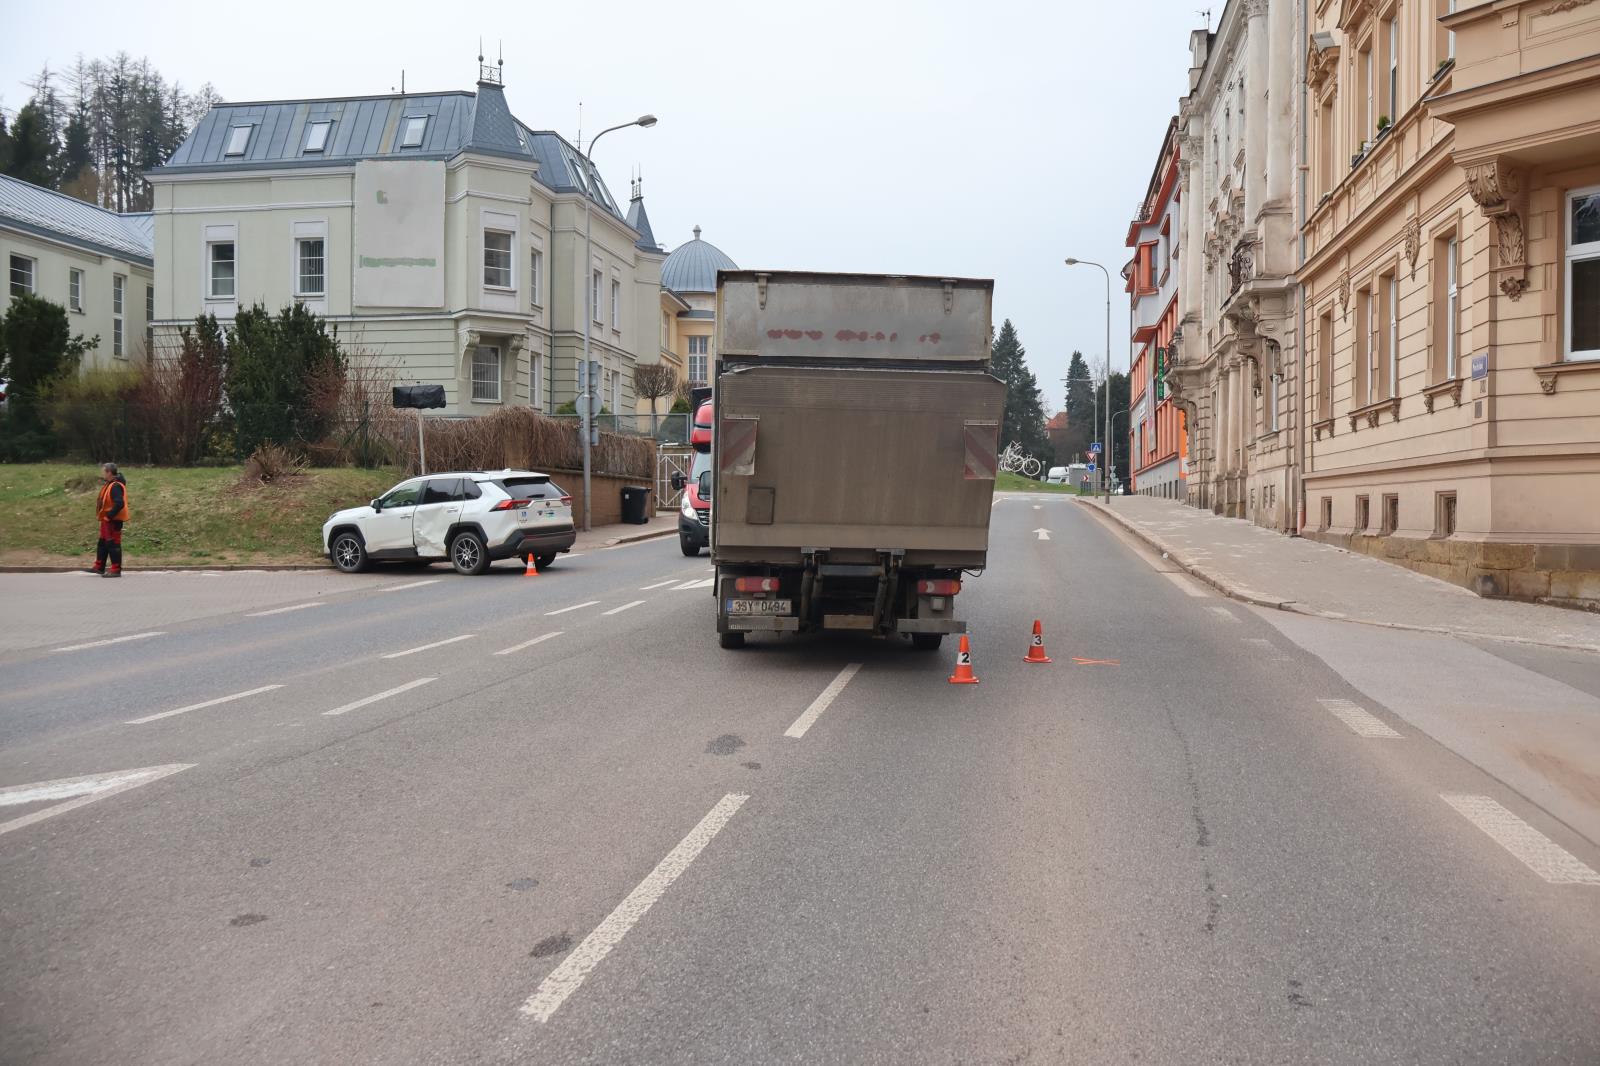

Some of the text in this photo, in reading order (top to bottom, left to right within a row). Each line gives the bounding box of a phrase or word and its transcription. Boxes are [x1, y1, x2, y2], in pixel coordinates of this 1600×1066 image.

[735, 601, 785, 612] 3SY 0494
[1034, 635, 1042, 645] 3
[961, 652, 970, 663] 2
